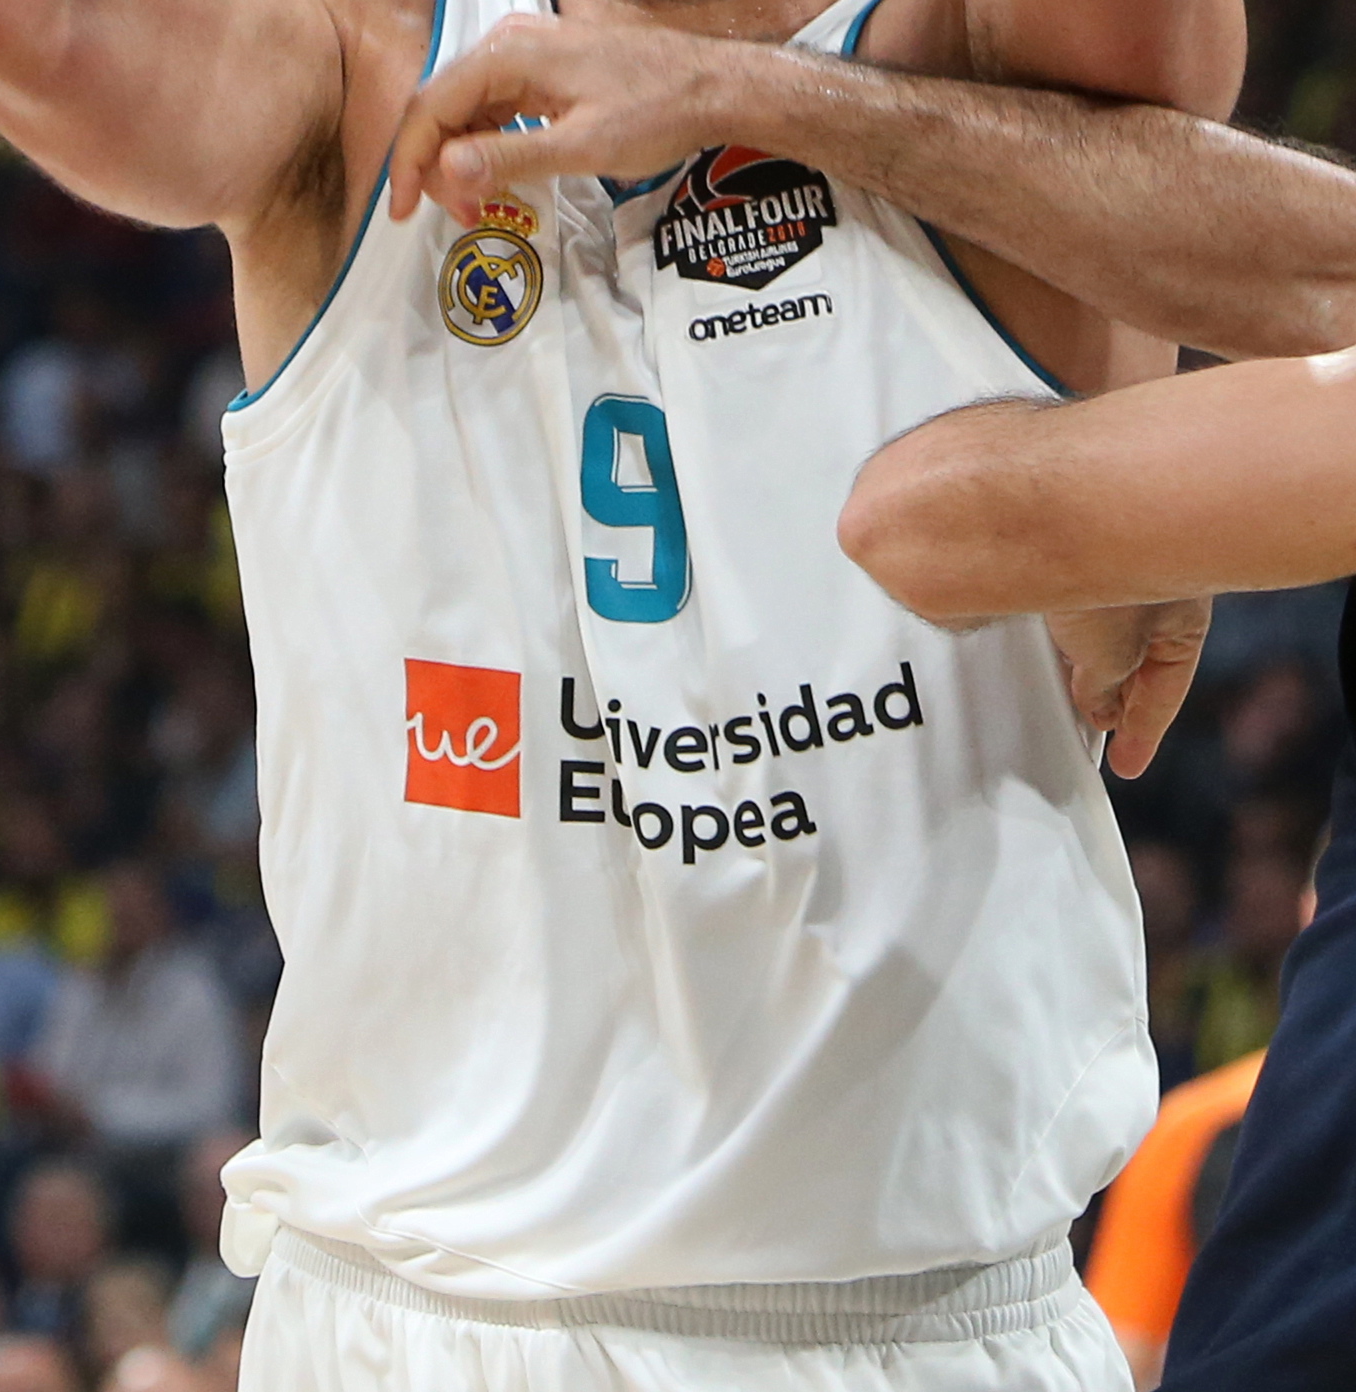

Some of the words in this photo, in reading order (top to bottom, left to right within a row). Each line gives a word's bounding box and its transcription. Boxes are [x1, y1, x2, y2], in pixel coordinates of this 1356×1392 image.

[660, 207, 743, 257] FINAL
[744, 184, 828, 229] FOUR
[688, 292, 833, 342] oneteam
[580, 392, 693, 623] 9
[560, 662, 925, 773] Uiversidad
